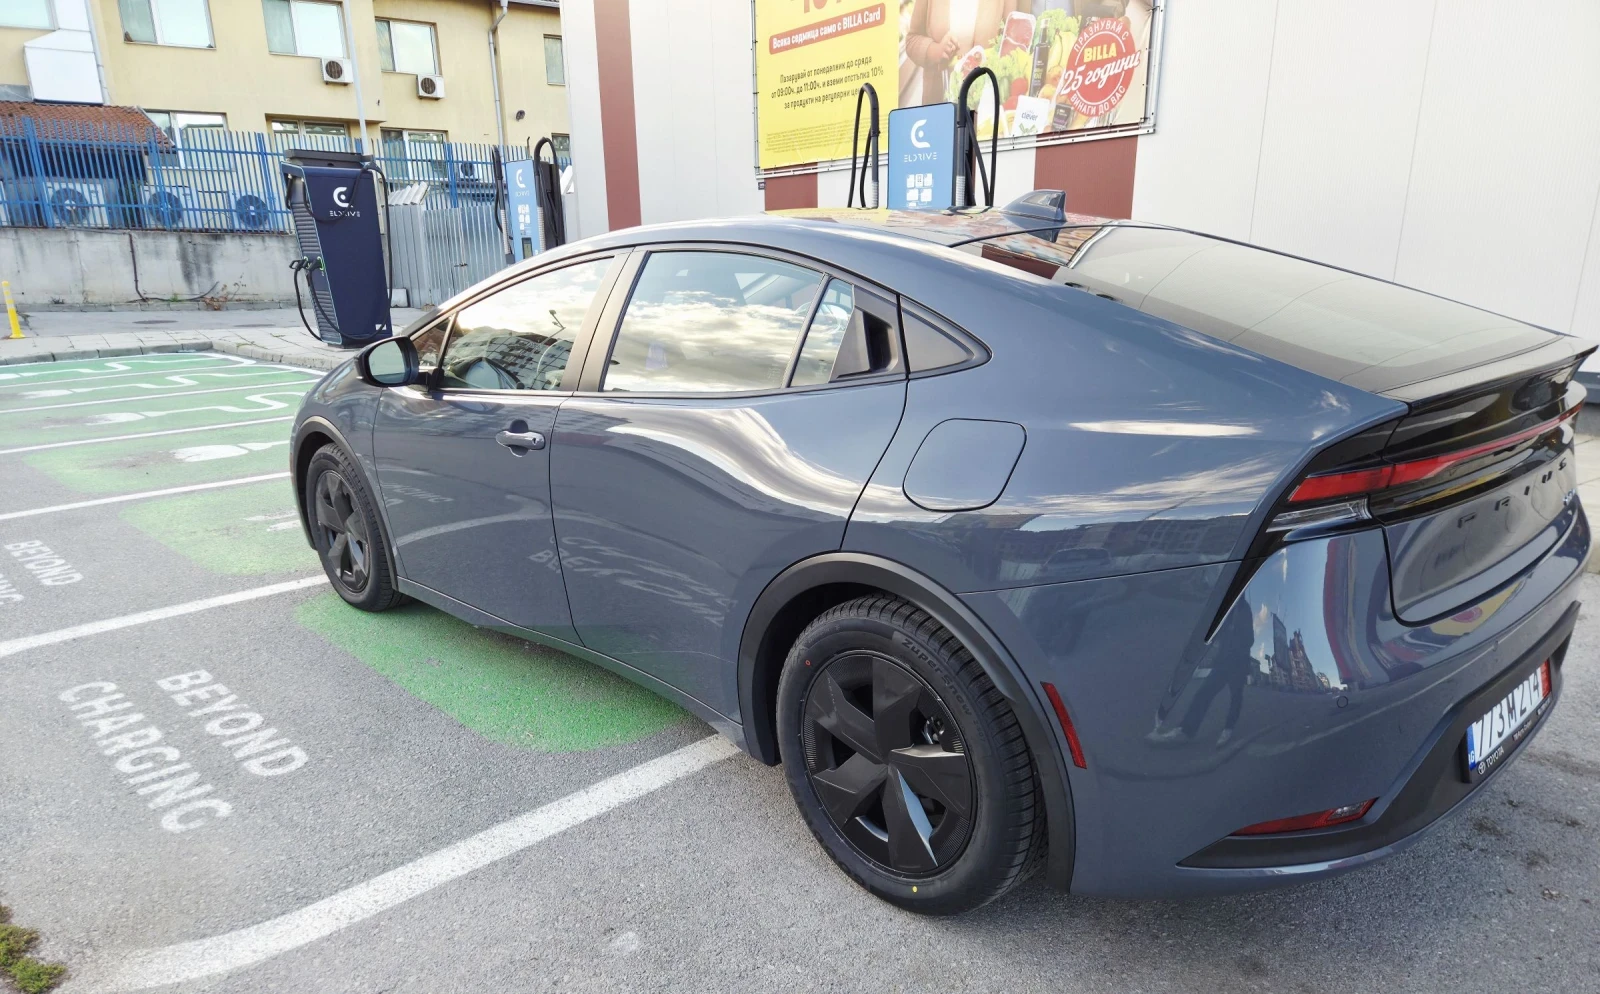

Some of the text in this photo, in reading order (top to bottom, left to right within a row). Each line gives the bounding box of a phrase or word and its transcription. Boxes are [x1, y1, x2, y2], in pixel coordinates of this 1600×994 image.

[772, 37, 791, 49] Всяка
[791, 29, 819, 44] седмица
[819, 24, 837, 36] само
[837, 22, 842, 30] с
[842, 14, 861, 30] BILLA
[864, 7, 881, 24] Card
[1074, 19, 1129, 52] ПРАЗНУВАЙ С
[1084, 43, 1117, 62] BILLA
[780, 56, 872, 84] Пазарувай от понеделник до сряда
[796, 85, 803, 94] до
[826, 75, 844, 87] вземи
[844, 71, 870, 83] отстъпка
[871, 66, 884, 77] 10%
[1060, 64, 1087, 95] 25
[1084, 50, 1141, 89] години
[784, 101, 790, 109] за
[791, 97, 814, 110] продукти
[822, 91, 850, 104] регулярни
[1071, 85, 1125, 116] ВИНАГИ ДО ВАС
[1021, 112, 1038, 122] clever
[904, 152, 937, 162] ELDRIVE
[4, 540, 84, 585] BEYOND
[157, 669, 309, 776] BEYOND
[60, 681, 232, 833] CHARGING
[1485, 746, 1505, 767] TOYOTA
